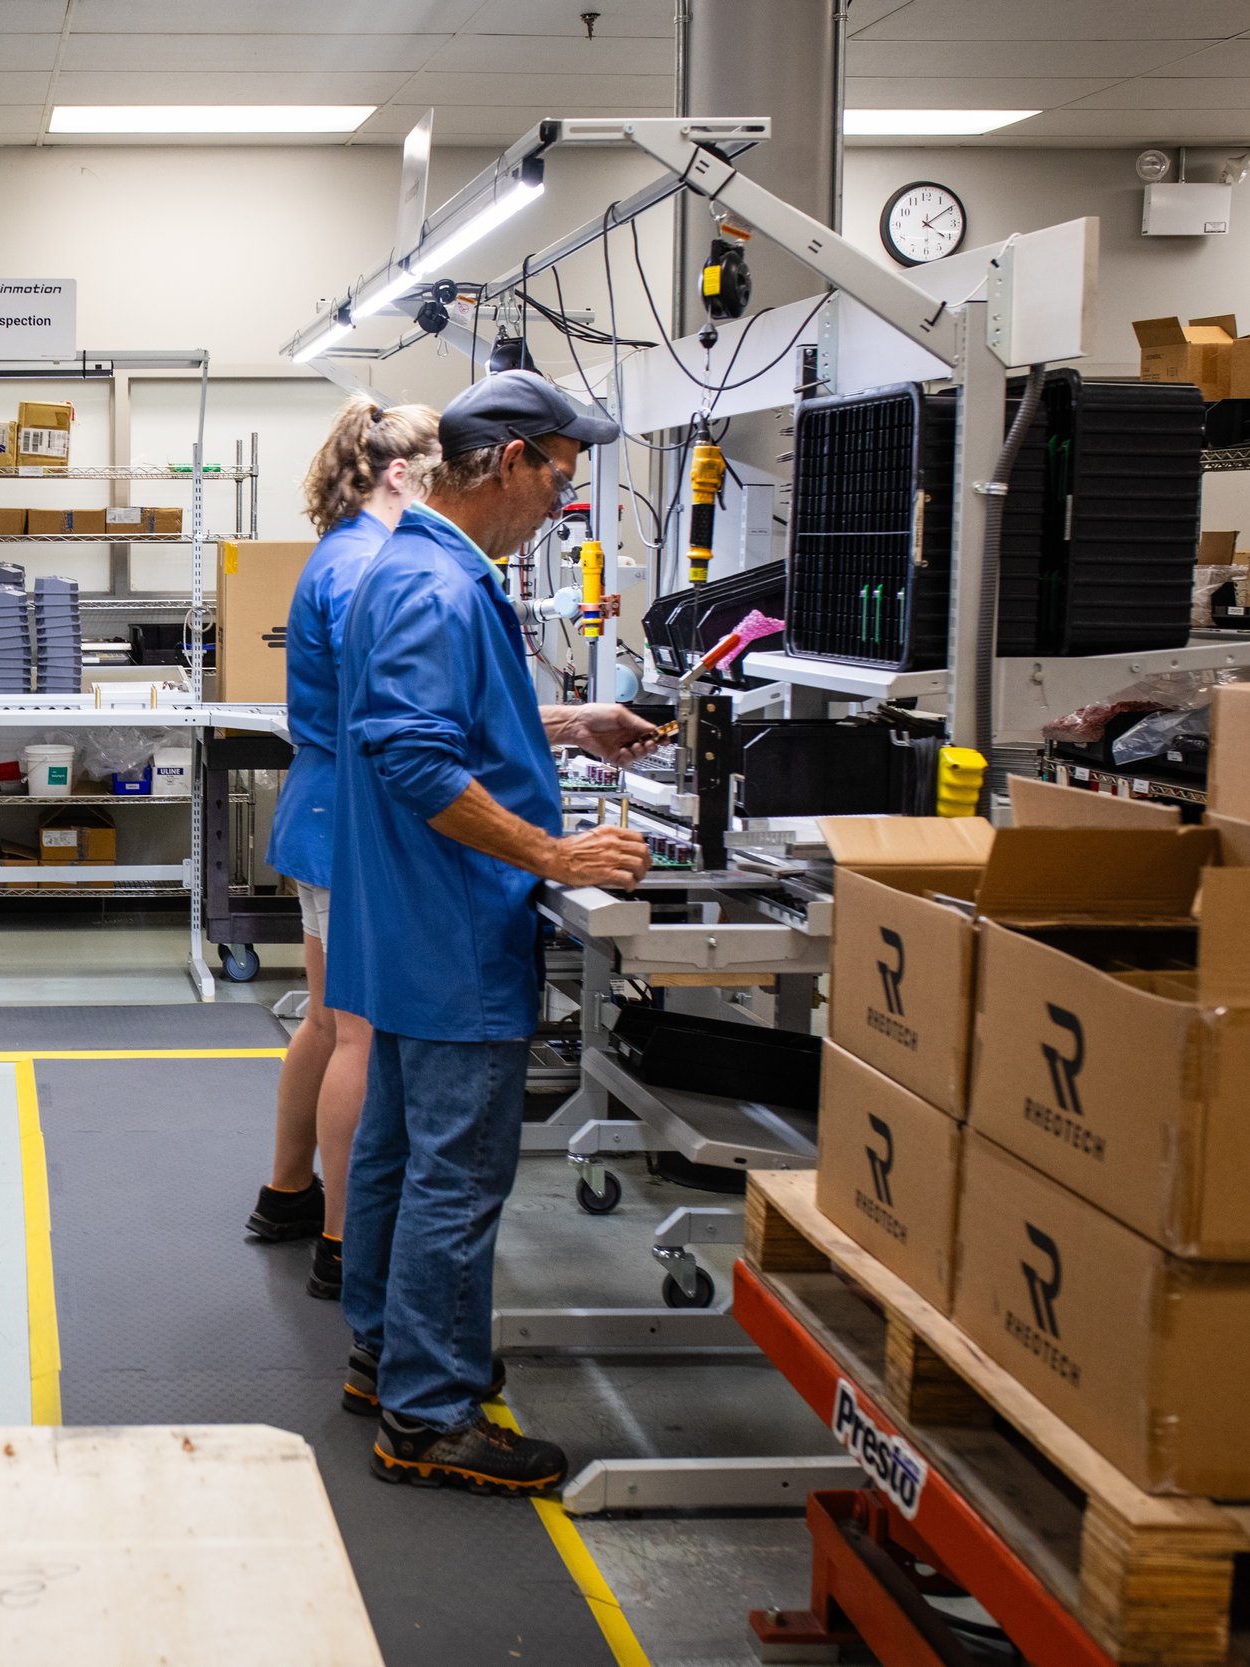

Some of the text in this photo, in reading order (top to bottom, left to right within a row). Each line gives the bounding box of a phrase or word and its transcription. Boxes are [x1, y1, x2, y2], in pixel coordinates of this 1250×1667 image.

[909, 197, 918, 206] 11
[922, 192, 932, 202] 12
[900, 208, 911, 217] 10
[895, 221, 902, 229] 9
[950, 219, 957, 228] 3
[923, 247, 930, 256] 6
[0, 283, 62, 294] inmotion
[867, 1006, 919, 1053] RHEOTECH
[1024, 1096, 1106, 1163] RHEOTECH
[855, 1188, 908, 1247] RHEOTECH
[1005, 1309, 1081, 1389] RHEOTECH
[836, 1387, 916, 1509] Presto
